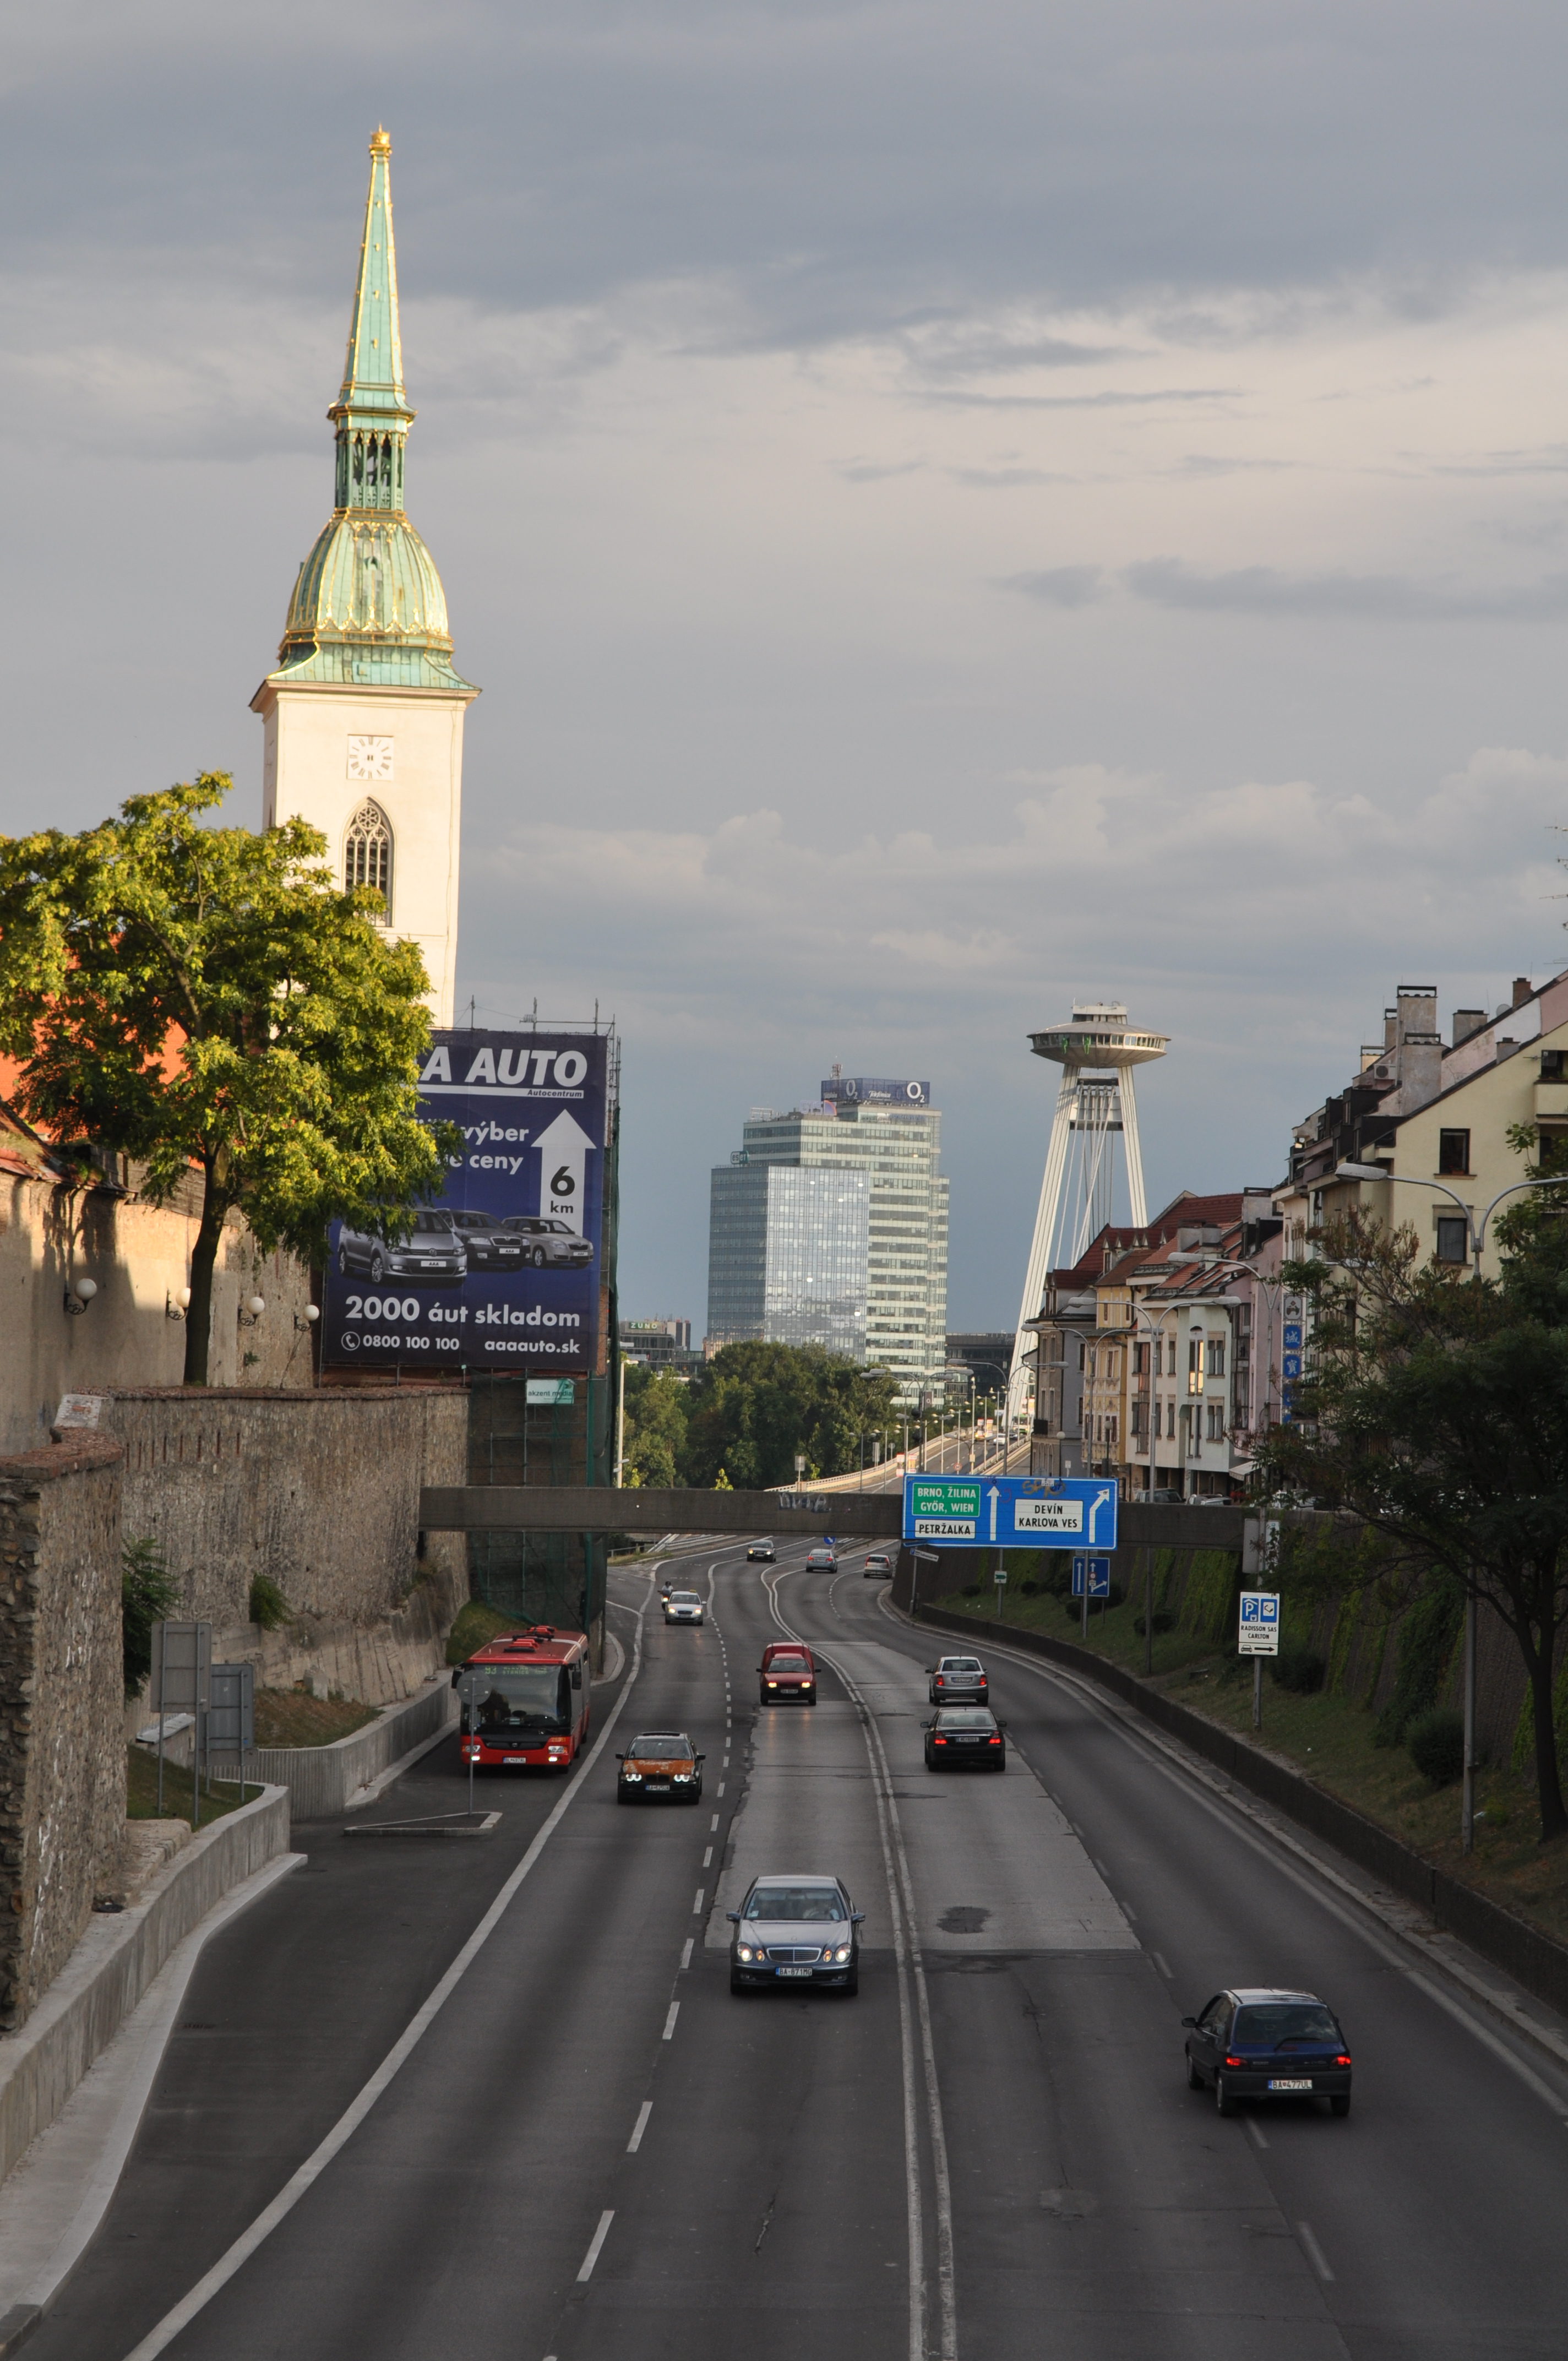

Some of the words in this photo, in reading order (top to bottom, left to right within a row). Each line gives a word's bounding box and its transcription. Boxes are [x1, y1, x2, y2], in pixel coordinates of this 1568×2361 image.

[464, 1047, 587, 1087] AUTO
[527, 1089, 582, 1097] Autocentrum
[460, 1121, 529, 1145] výber
[470, 1155, 524, 1175] ceny
[550, 1166, 575, 1196] 6
[551, 1200, 574, 1214] km
[345, 1296, 420, 1321] 2000
[428, 1302, 468, 1323] áut
[475, 1304, 580, 1327] skladom
[363, 1335, 400, 1348] 0800
[405, 1336, 430, 1350] 100
[435, 1337, 460, 1351] 100
[484, 1339, 580, 1354] aaaauto.sk
[917, 1488, 945, 1499] BRNO,
[947, 1486, 976, 1498] ŽILINA
[950, 1503, 974, 1513] WIEN
[1035, 1503, 1063, 1515] DEVÍN
[919, 1522, 971, 1535] PETRŽALKA
[1019, 1517, 1058, 1527] KARLOVA
[1061, 1518, 1077, 1528] VES
